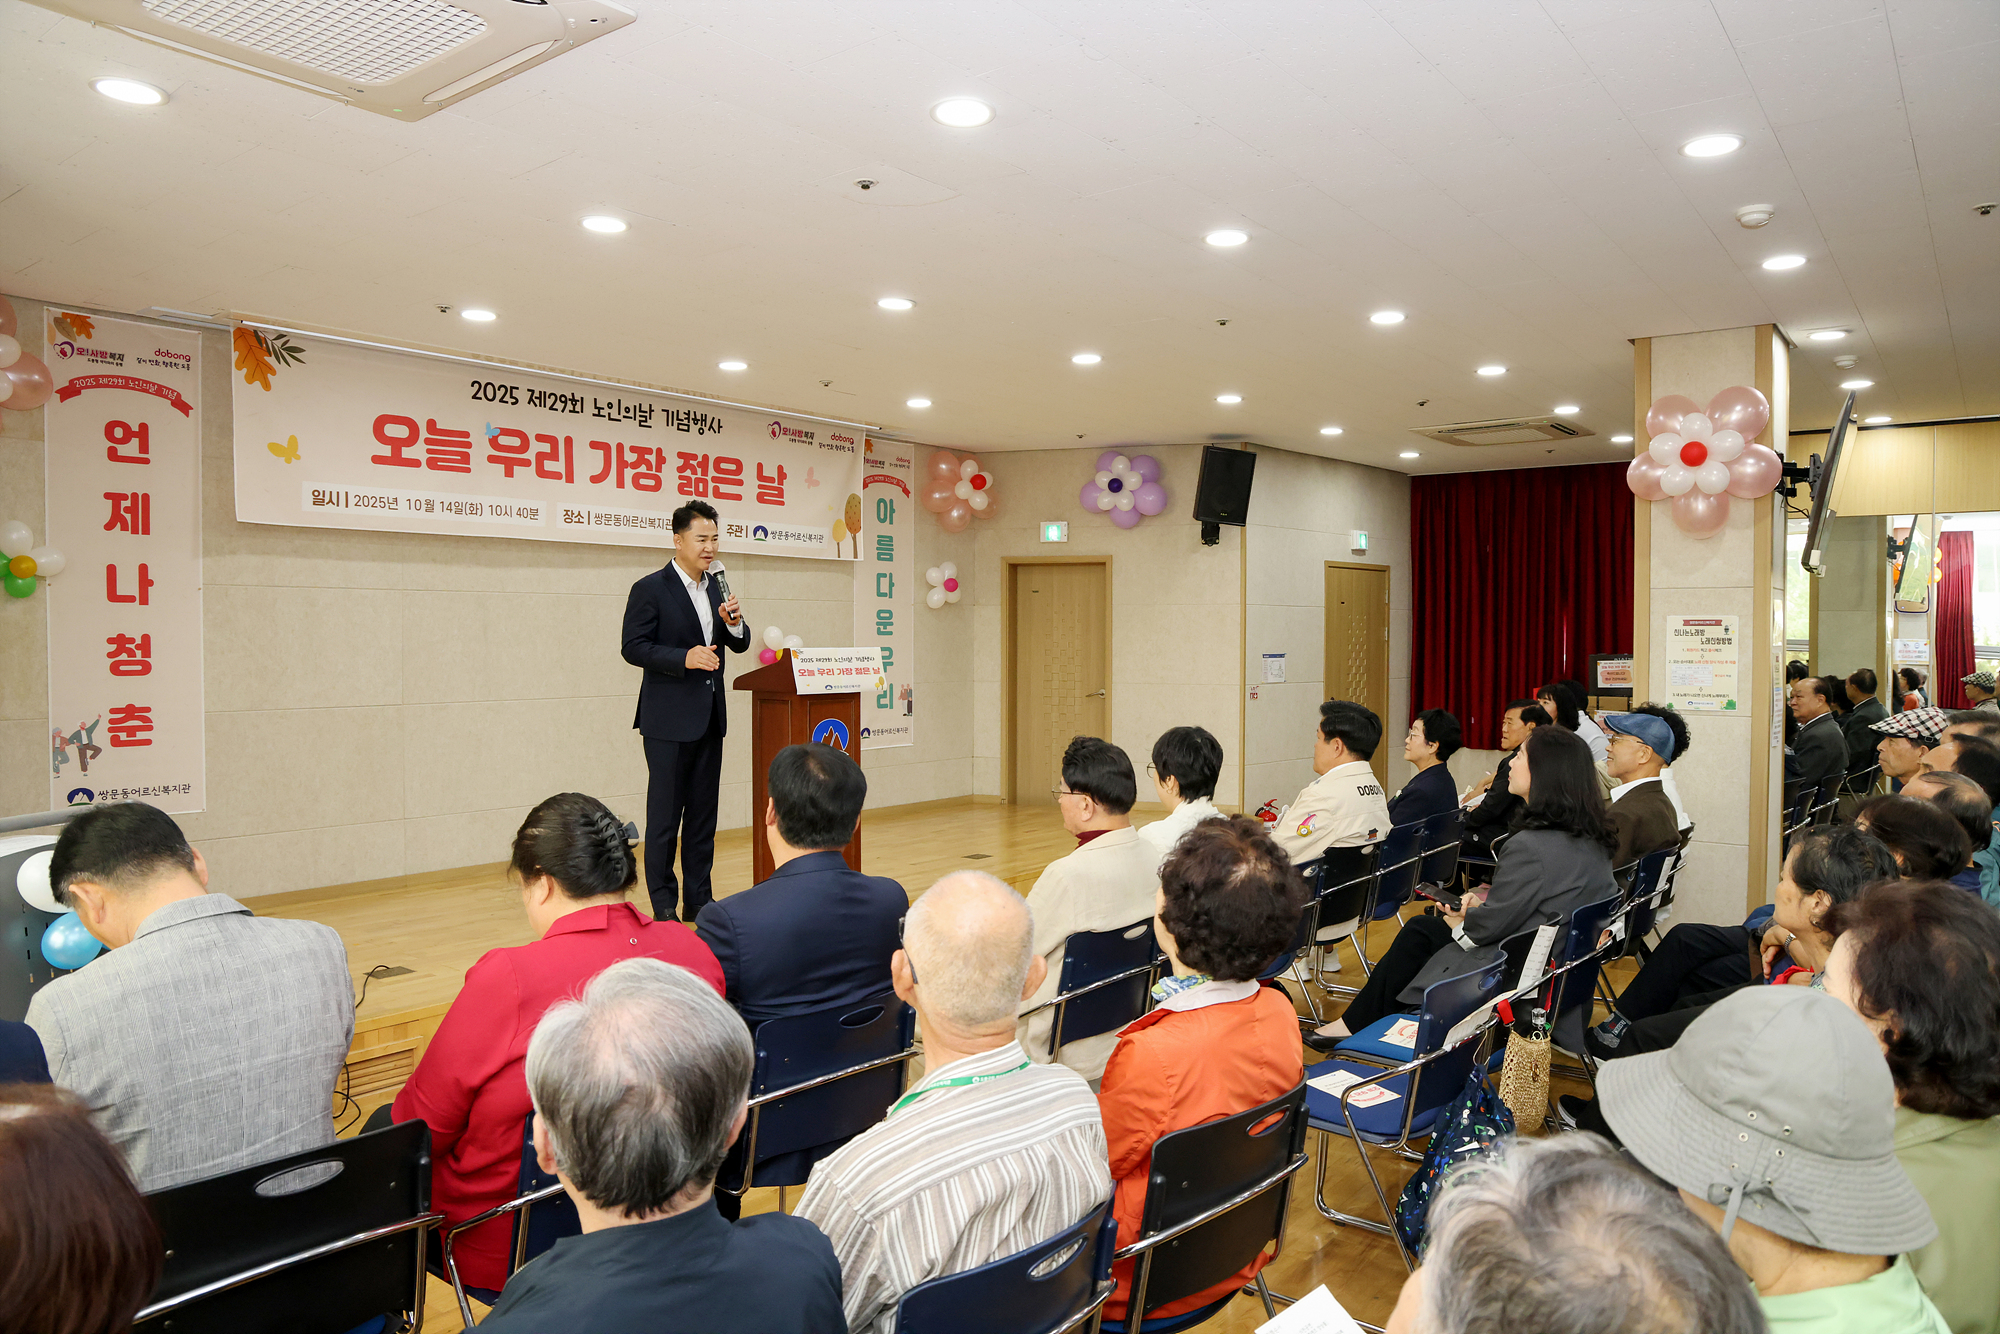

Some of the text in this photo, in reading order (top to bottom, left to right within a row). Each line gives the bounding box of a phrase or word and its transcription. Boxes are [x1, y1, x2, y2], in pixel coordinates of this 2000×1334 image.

[154, 348, 191, 362] dobong
[181, 363, 190, 371] 도봉
[74, 377, 178, 400] 2025 제29회 노인의날 기념
[471, 380, 723, 436] 2025 제29회 노인의날 기념행사
[830, 432, 855, 445] dobong
[370, 413, 788, 506] 오늘 우리 가장 젊은 날
[311, 489, 539, 521] 일시 2025년 10월 14일(화) 10시 40분
[563, 509, 673, 531] 장소 쌍문동어르신복지관
[726, 524, 825, 544] 주관 쌍문동어르신복지관
[103, 419, 155, 749] 언제나청춘
[798, 666, 881, 677] 오늘 우리 가장 젊은 날
[97, 782, 192, 801] 쌍문동어르신복지관
